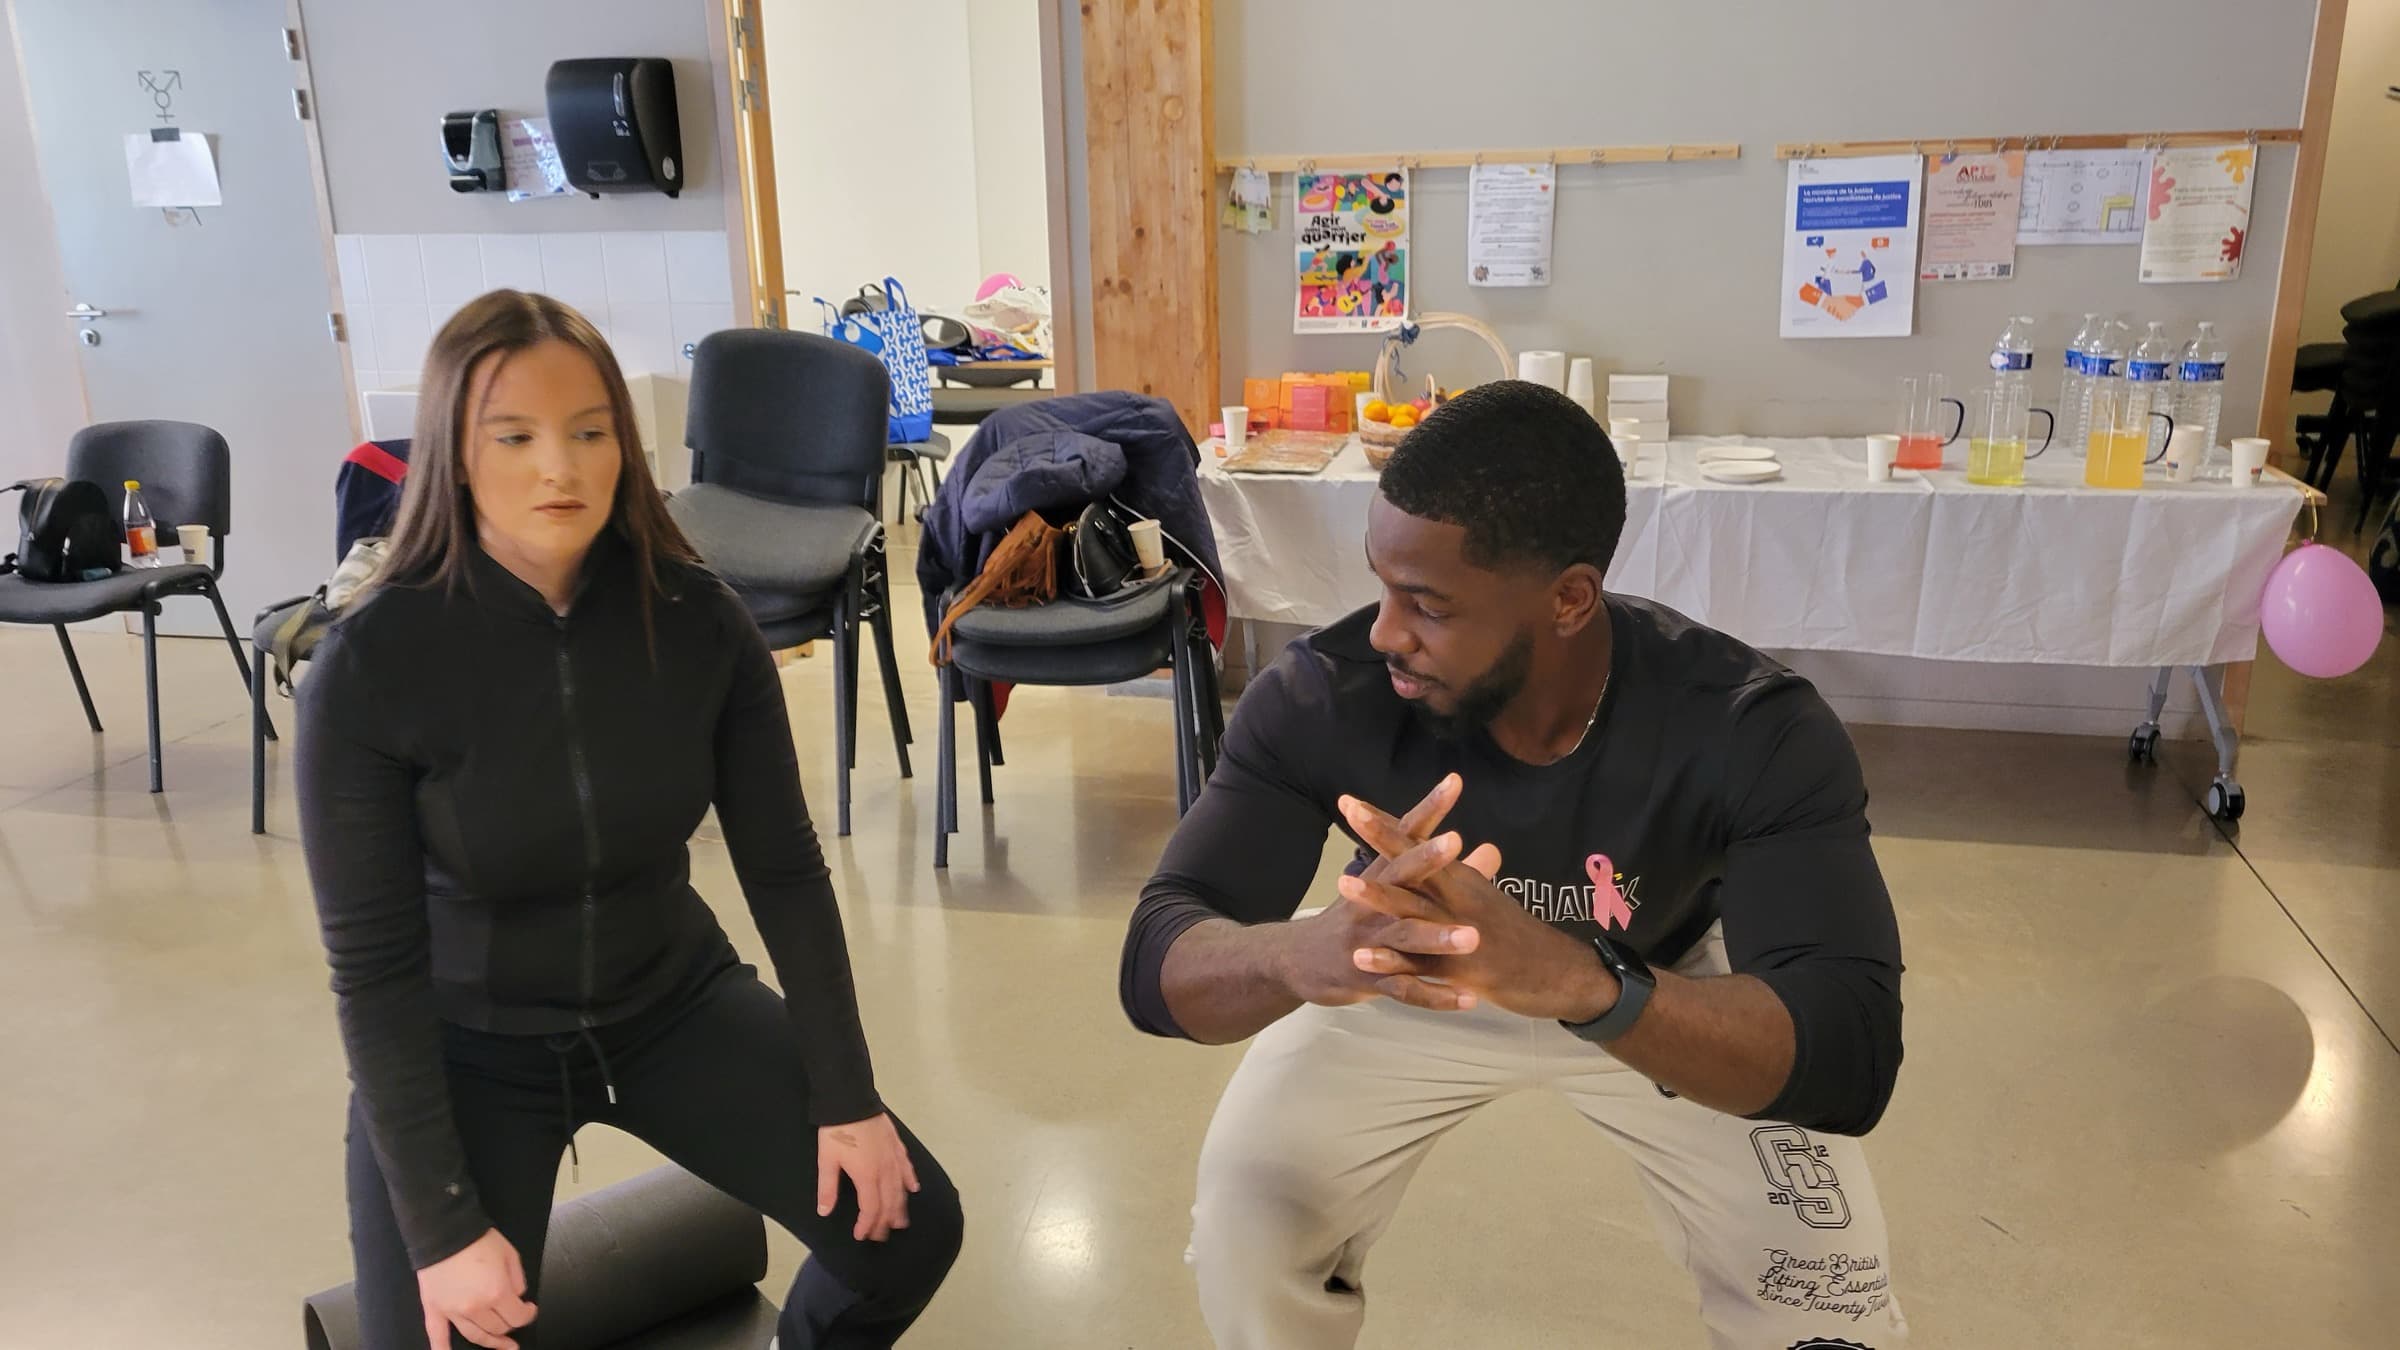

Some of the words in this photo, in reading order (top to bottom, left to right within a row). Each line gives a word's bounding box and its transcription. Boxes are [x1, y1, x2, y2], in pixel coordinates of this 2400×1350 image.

[1311, 213, 1340, 229] Agir
[1302, 229, 1367, 245] quartier
[1814, 1145, 1829, 1157] 12
[1767, 1192, 1790, 1205] 20
[1762, 1248, 1827, 1271] Great
[1829, 1253, 1881, 1275] British
[1757, 1265, 1820, 1292] Lifting
[1757, 1282, 1804, 1307] Since
[1802, 1288, 1867, 1321] Twenty
